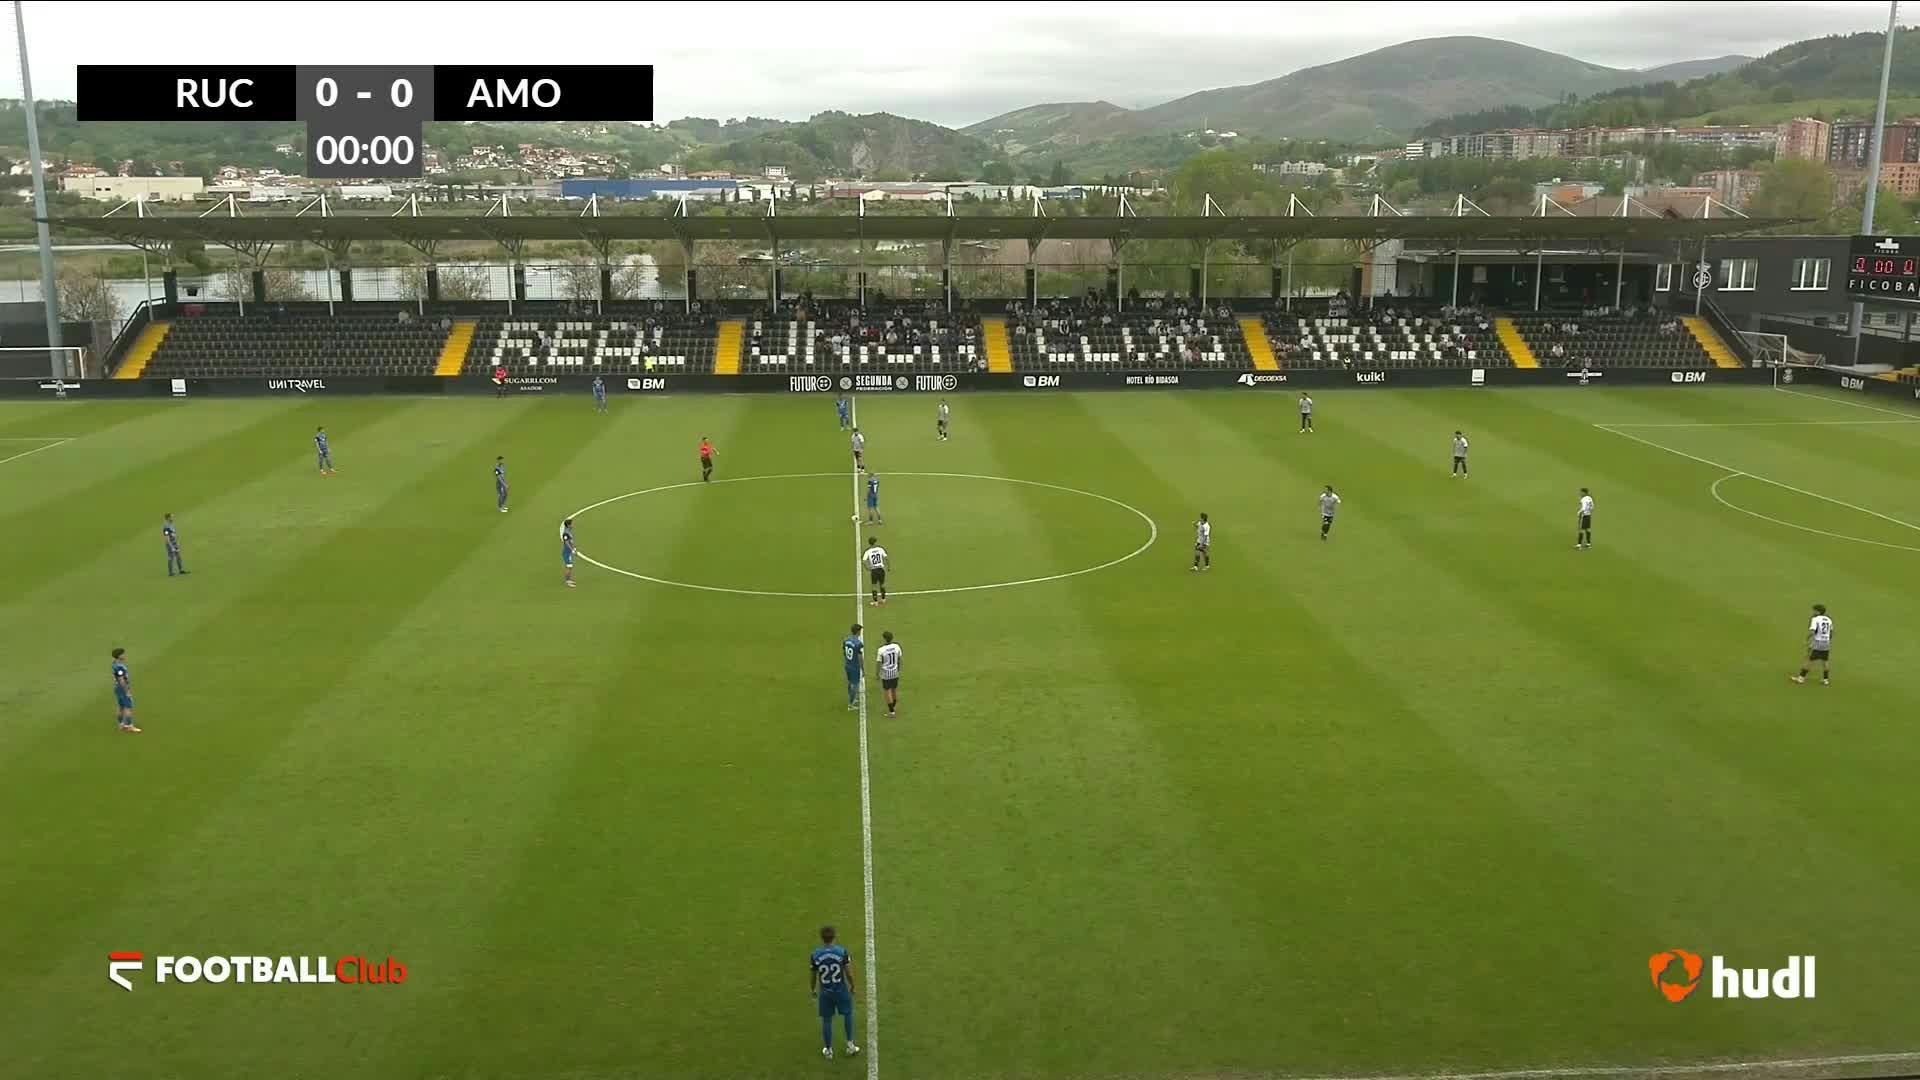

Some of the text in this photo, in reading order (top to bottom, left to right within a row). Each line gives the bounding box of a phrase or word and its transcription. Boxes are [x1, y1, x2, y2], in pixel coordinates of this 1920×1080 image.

[1849, 279, 1915, 292] FICOBA
[855, 375, 892, 386] SEGUNDA
[1037, 375, 1060, 387] BM
[1126, 376, 1143, 384] HOTEL
[1356, 371, 1385, 382] kuik!
[1684, 371, 1706, 383] BM
[642, 378, 665, 390] BM
[819, 963, 842, 984] 22
